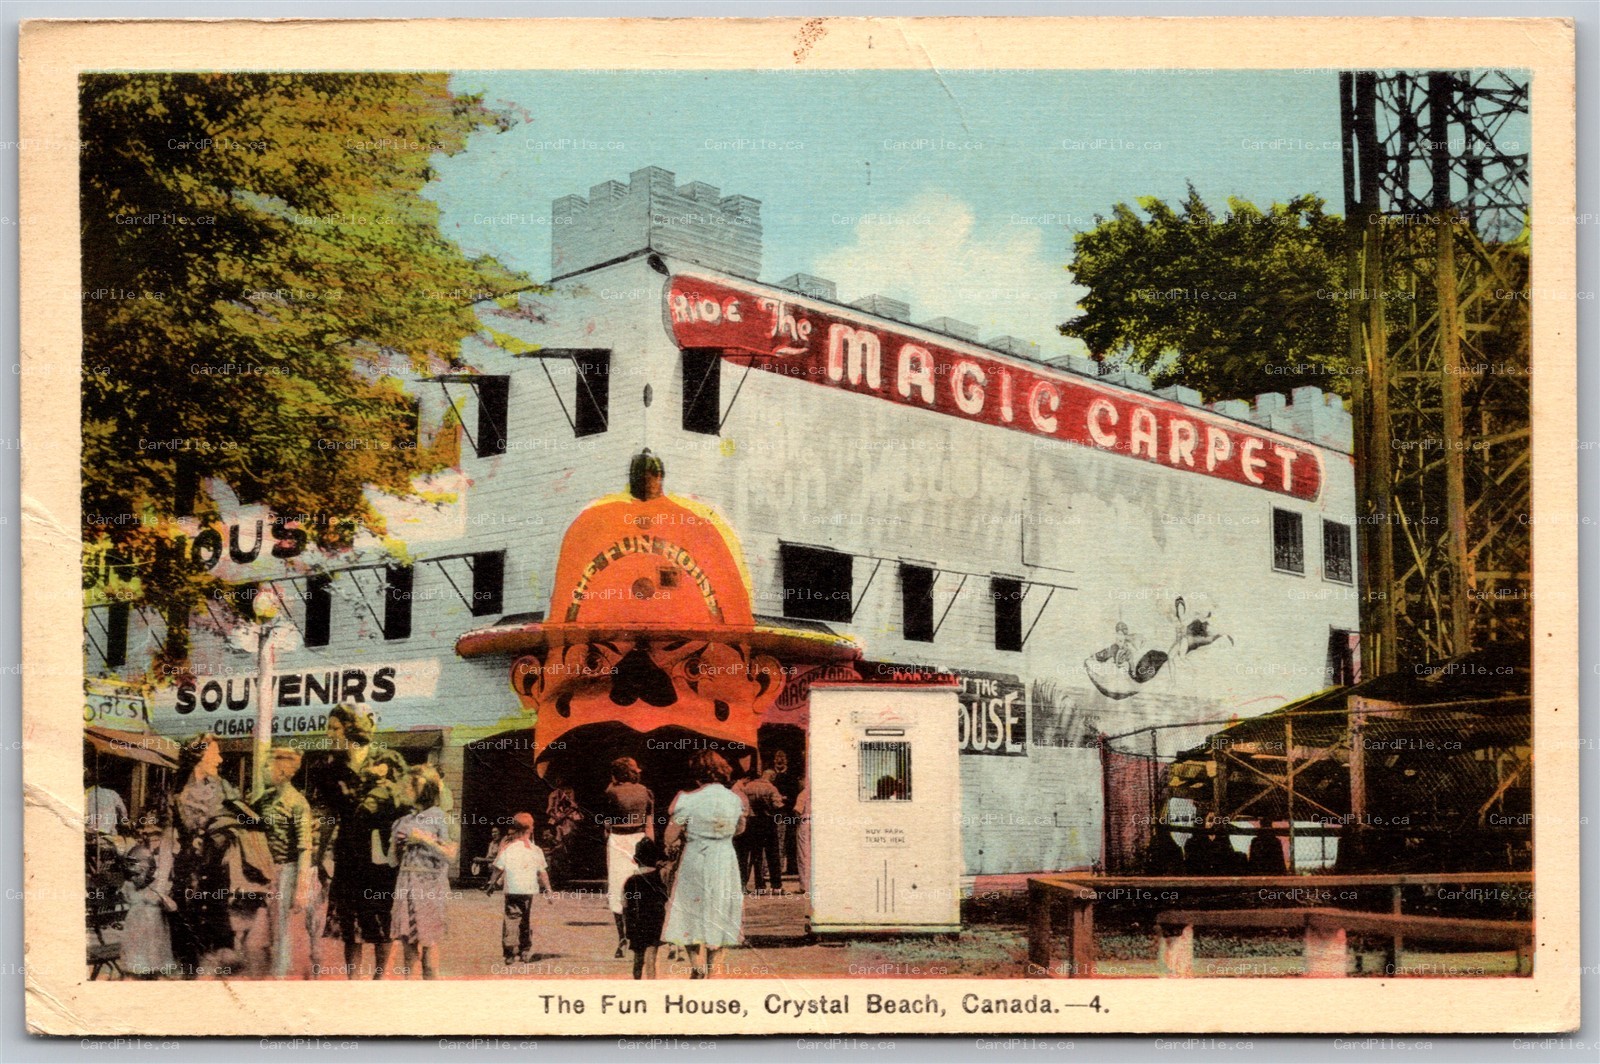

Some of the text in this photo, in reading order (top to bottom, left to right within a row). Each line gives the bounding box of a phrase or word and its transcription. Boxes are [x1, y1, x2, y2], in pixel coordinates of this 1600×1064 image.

[755, 299, 812, 342] The
[827, 323, 1059, 434] MAGIC
[1087, 398, 1297, 492] CARPET
[604, 533, 653, 561] FUN
[972, 678, 999, 697] THE
[213, 717, 256, 736] CIGAR
[958, 690, 1023, 753] OUSE
[538, 994, 586, 1015] The
[601, 994, 648, 1015] Fun
[664, 994, 749, 1018] House,
[764, 993, 850, 1018] Crystal
[866, 993, 947, 1017] Beach,
